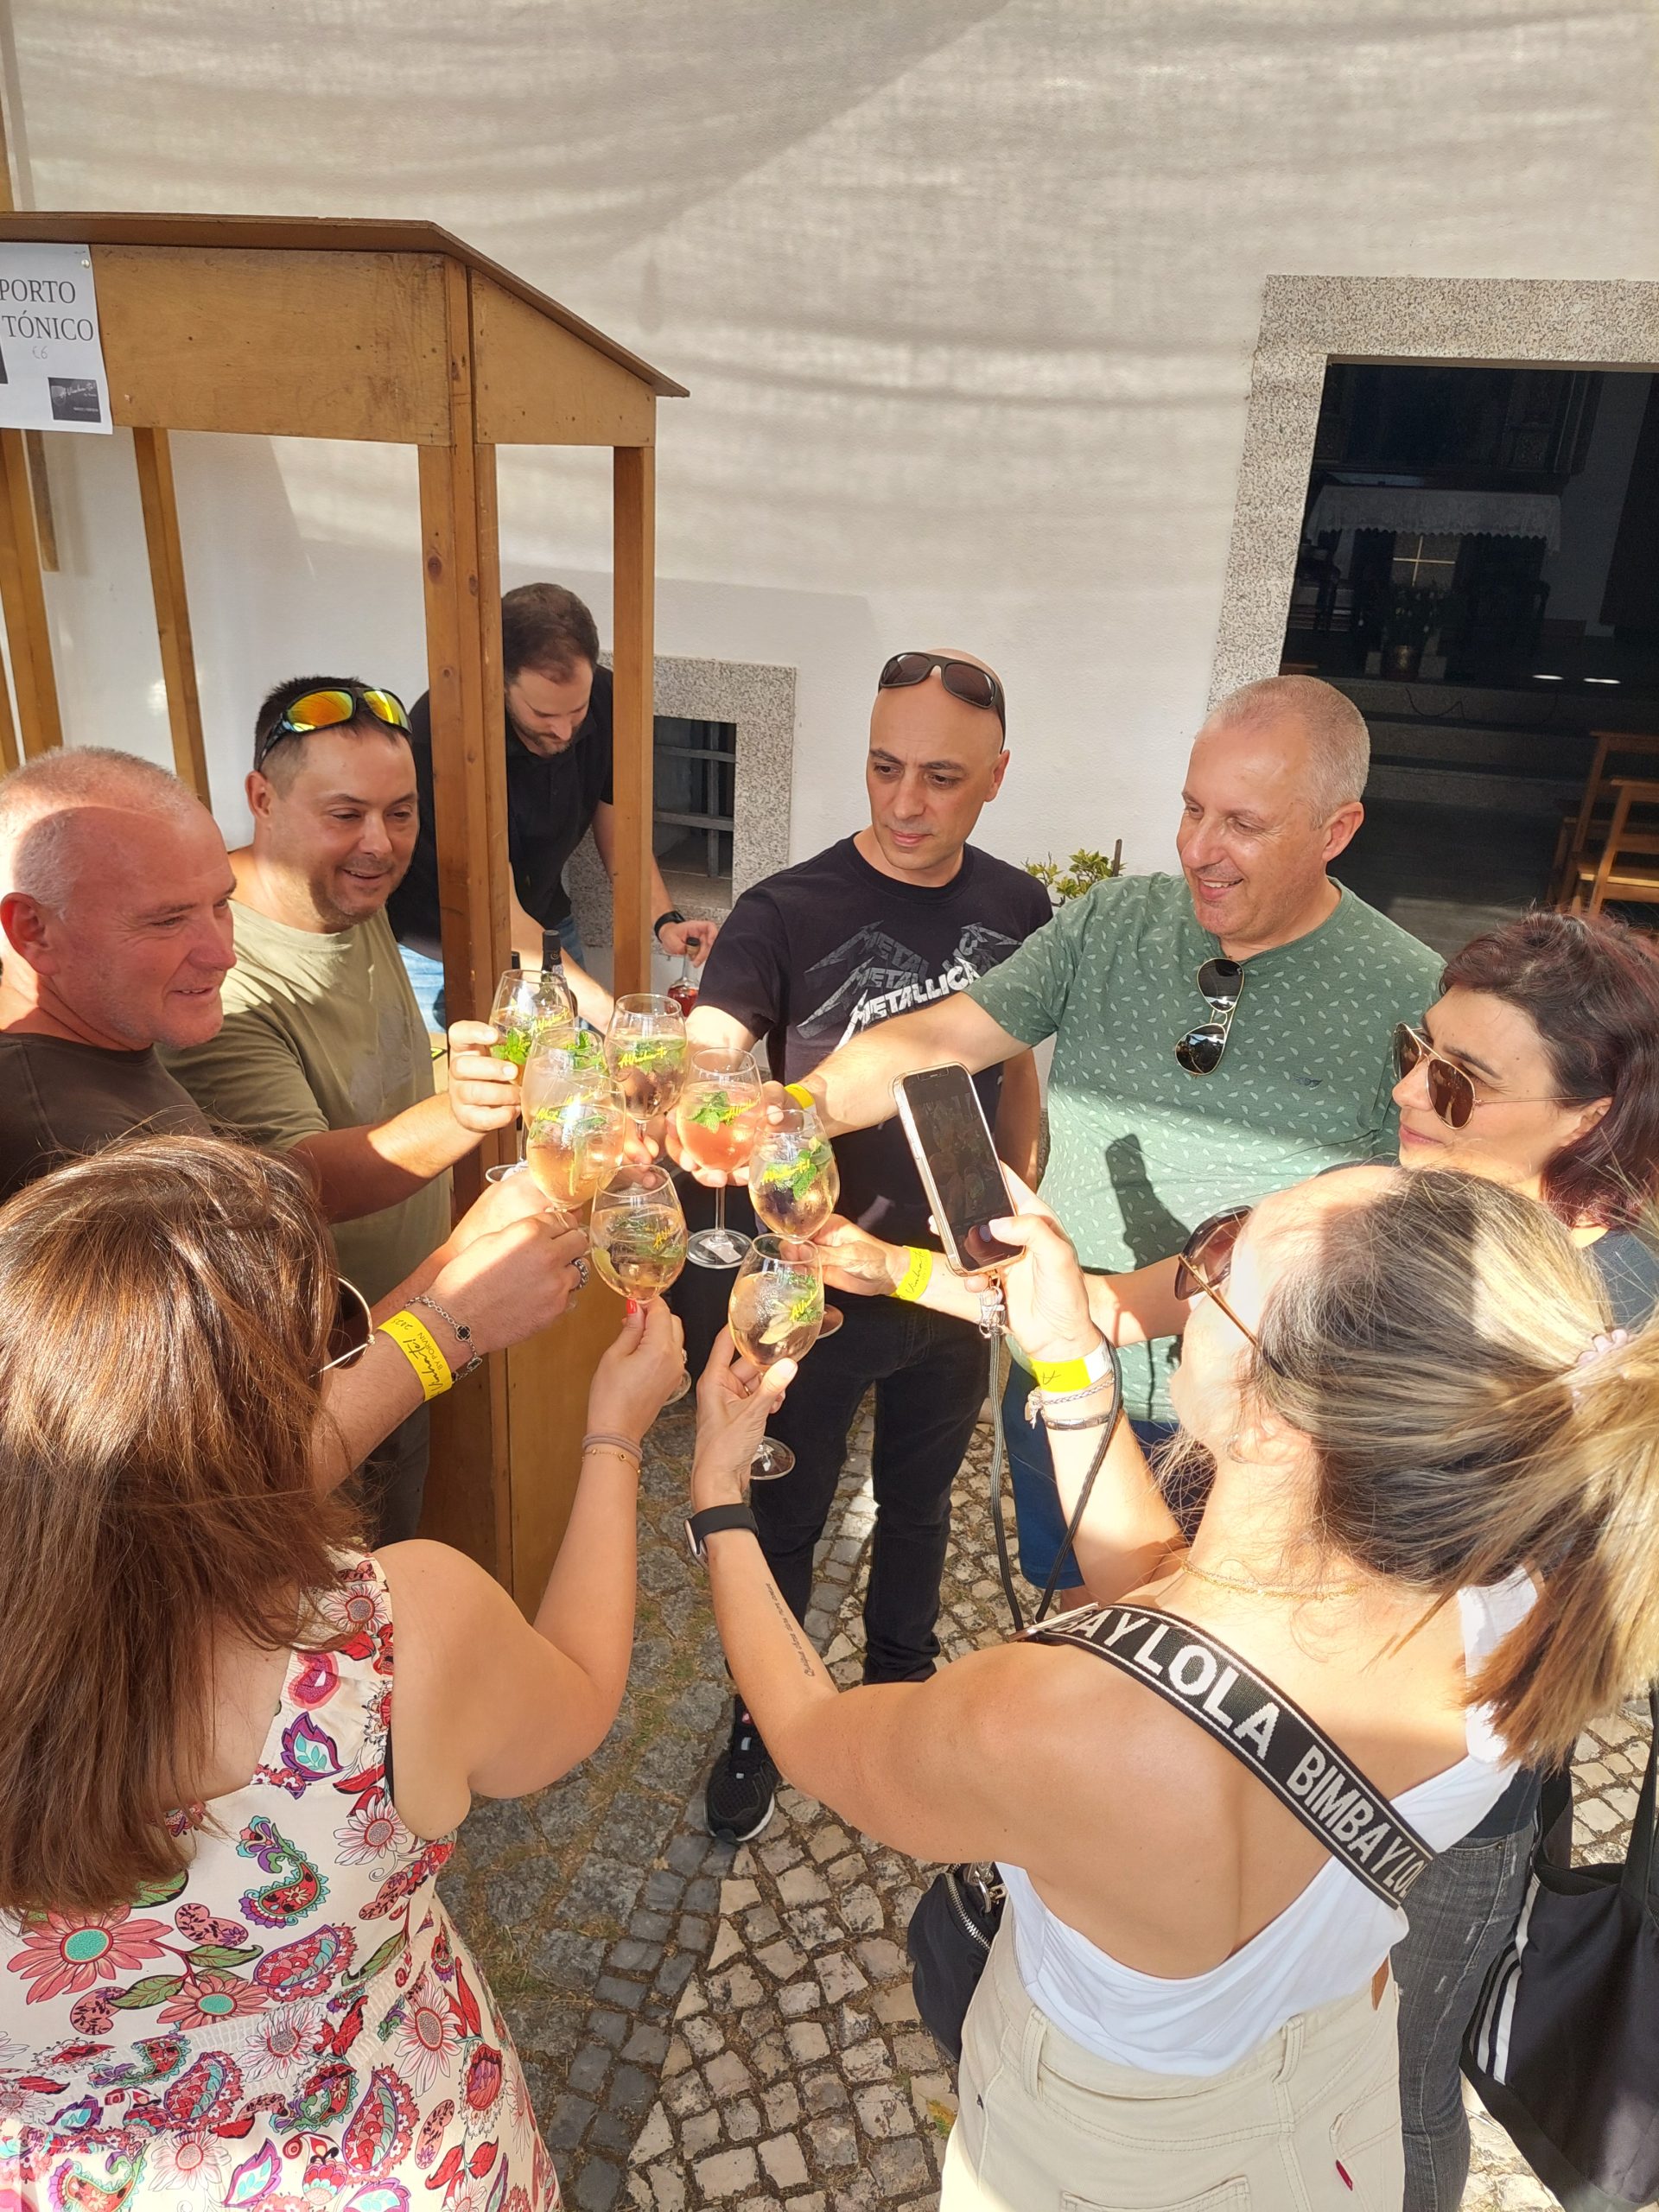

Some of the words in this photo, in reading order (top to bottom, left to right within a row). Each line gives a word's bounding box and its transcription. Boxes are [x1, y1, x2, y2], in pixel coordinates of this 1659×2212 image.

[0, 279, 76, 303] PORTO
[2, 310, 94, 341] TÓNICO
[1287, 1745, 1428, 1900] BIMBAYLOL
